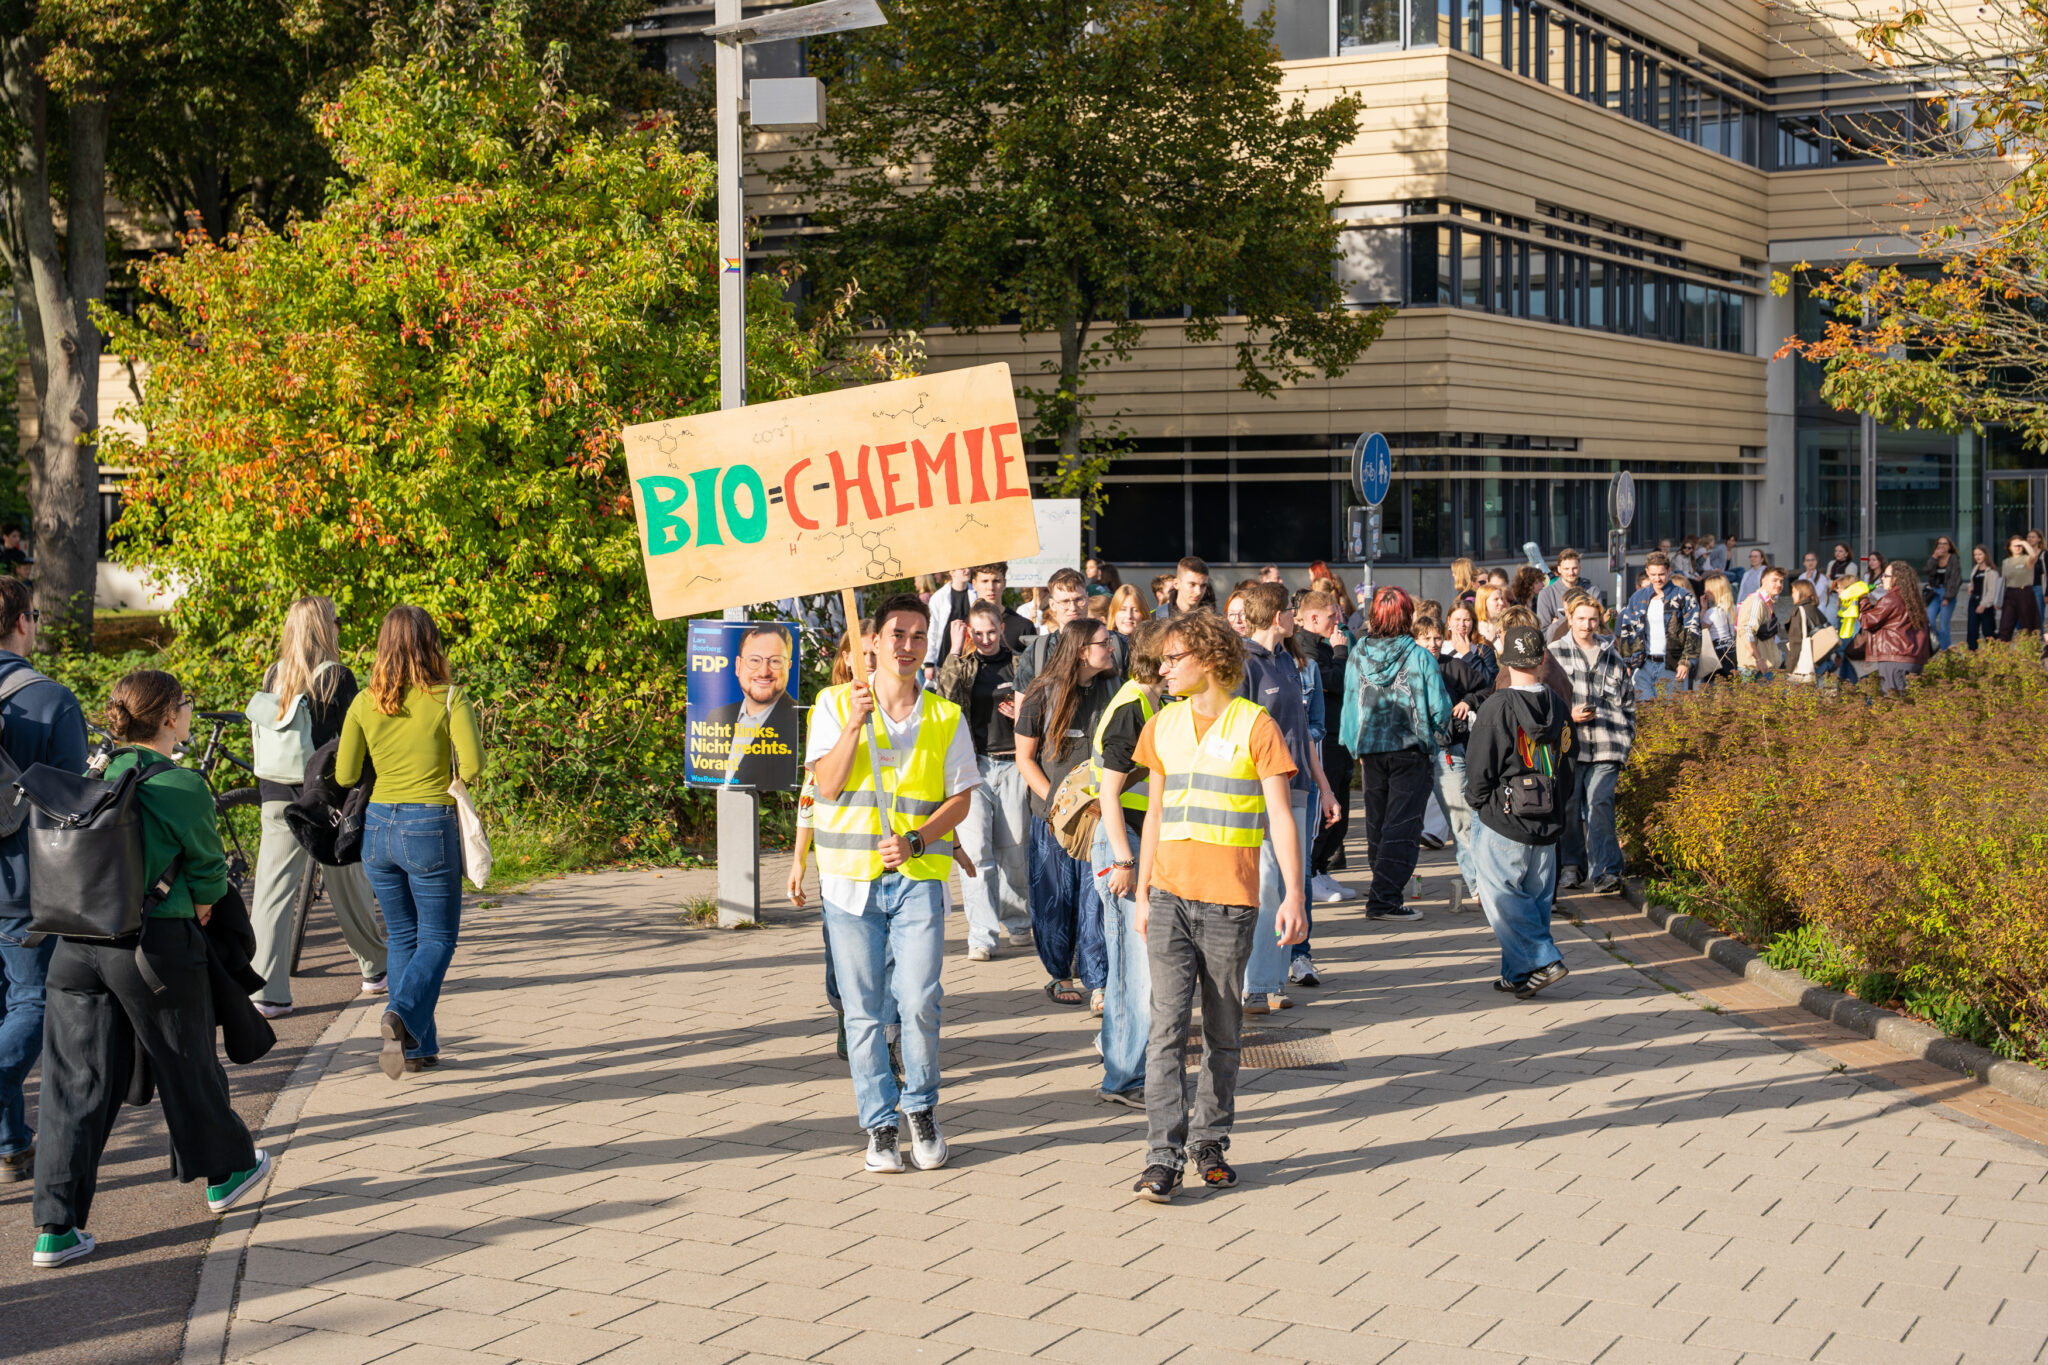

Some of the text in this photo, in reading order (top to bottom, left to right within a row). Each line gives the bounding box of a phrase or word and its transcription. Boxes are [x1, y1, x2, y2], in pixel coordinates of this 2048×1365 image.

[789, 543, 797, 556] H
[691, 654, 729, 673] FDP
[691, 720, 779, 738] Nicht links.
[690, 737, 793, 755] Nicht rechts.
[689, 753, 739, 771] Voran!
[690, 774, 740, 785] WasReissede
